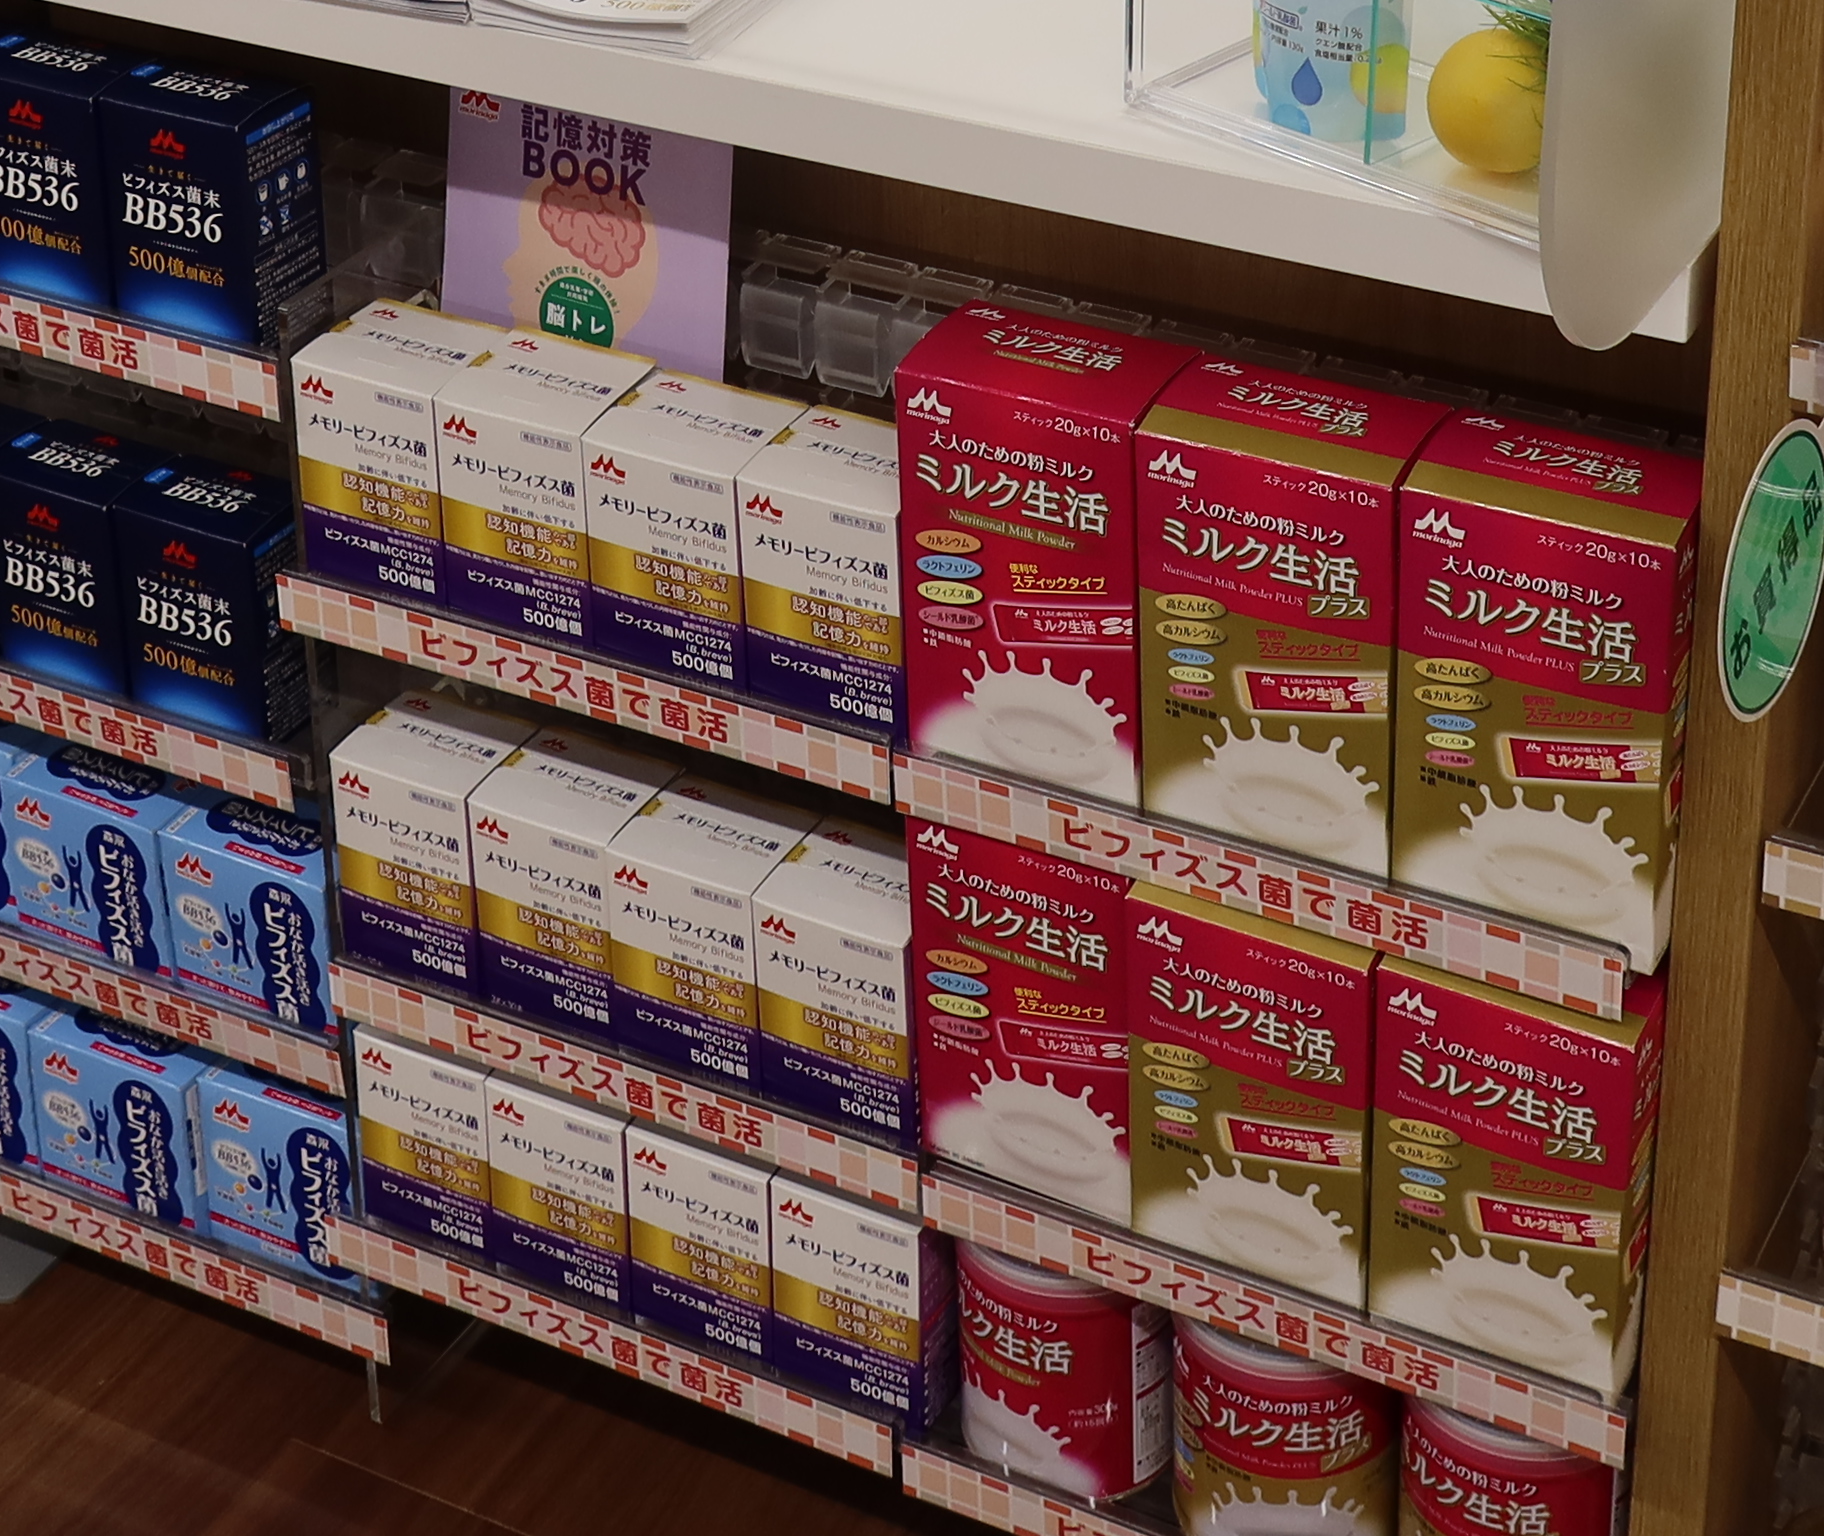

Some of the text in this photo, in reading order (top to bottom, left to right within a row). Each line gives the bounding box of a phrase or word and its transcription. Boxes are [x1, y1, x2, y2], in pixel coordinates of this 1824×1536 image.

[521, 105, 651, 168] 記憶対策
[121, 172, 221, 209] ビフィズス菌末
[522, 142, 647, 206] BOOK
[122, 192, 224, 243] BB536
[128, 246, 225, 287] 500億個配合
[546, 302, 608, 336] 脳トレ
[308, 413, 428, 457] メモリービフィズス菌
[906, 409, 951, 425] morinaga
[929, 429, 1094, 481] 大人のための粉ミルク
[915, 452, 1109, 536] ミルク生活
[925, 535, 971, 550] カルシウム
[948, 509, 1077, 550] Nutritional Milk Powder
[378, 565, 436, 595] 500億個
[753, 534, 888, 581] メモリービフィズス菌
[805, 565, 888, 593] Memory Bifidus
[920, 559, 977, 575] ラクトフェリン
[1731, 471, 1824, 678] お買得品
[925, 585, 975, 602] ビフィズス菌
[1013, 574, 1106, 592] スティックタイプ
[1440, 556, 1623, 609] 大人のための粉ミルク
[138, 594, 233, 647] BB536
[1424, 580, 1637, 663] ミルク生活
[143, 642, 236, 687] 500億個配合
[420, 629, 729, 743] ビフィズス菌で菌活
[770, 652, 893, 696] ビフィズス菌MCC1274
[1425, 662, 1480, 680] 高たんぱく
[1581, 662, 1643, 684] プラス
[830, 694, 894, 723] 500億個
[1418, 688, 1485, 707] 高カルシウム
[1062, 816, 1429, 950] ビフィズス菌で菌活
[925, 883, 1108, 972] ミルク生活
[286, 913, 311, 1007] おなか活き活き
[1149, 976, 1336, 1064] ミルク生活
[466, 1024, 764, 1147] ビフィズス菌で菌活
[9, 1188, 261, 1305] ビフィズス菌で菌活
[785, 1234, 909, 1288] メモリービフィズス菌
[1084, 1244, 1440, 1392] ビフィズス菌で菌活
[458, 1278, 743, 1408] ビフィズス菌で菌活
[850, 1379, 909, 1410] 500億個
[1201, 1375, 1354, 1418] 大人のための粉ミルク
[1194, 1389, 1364, 1455] ミルク生活
